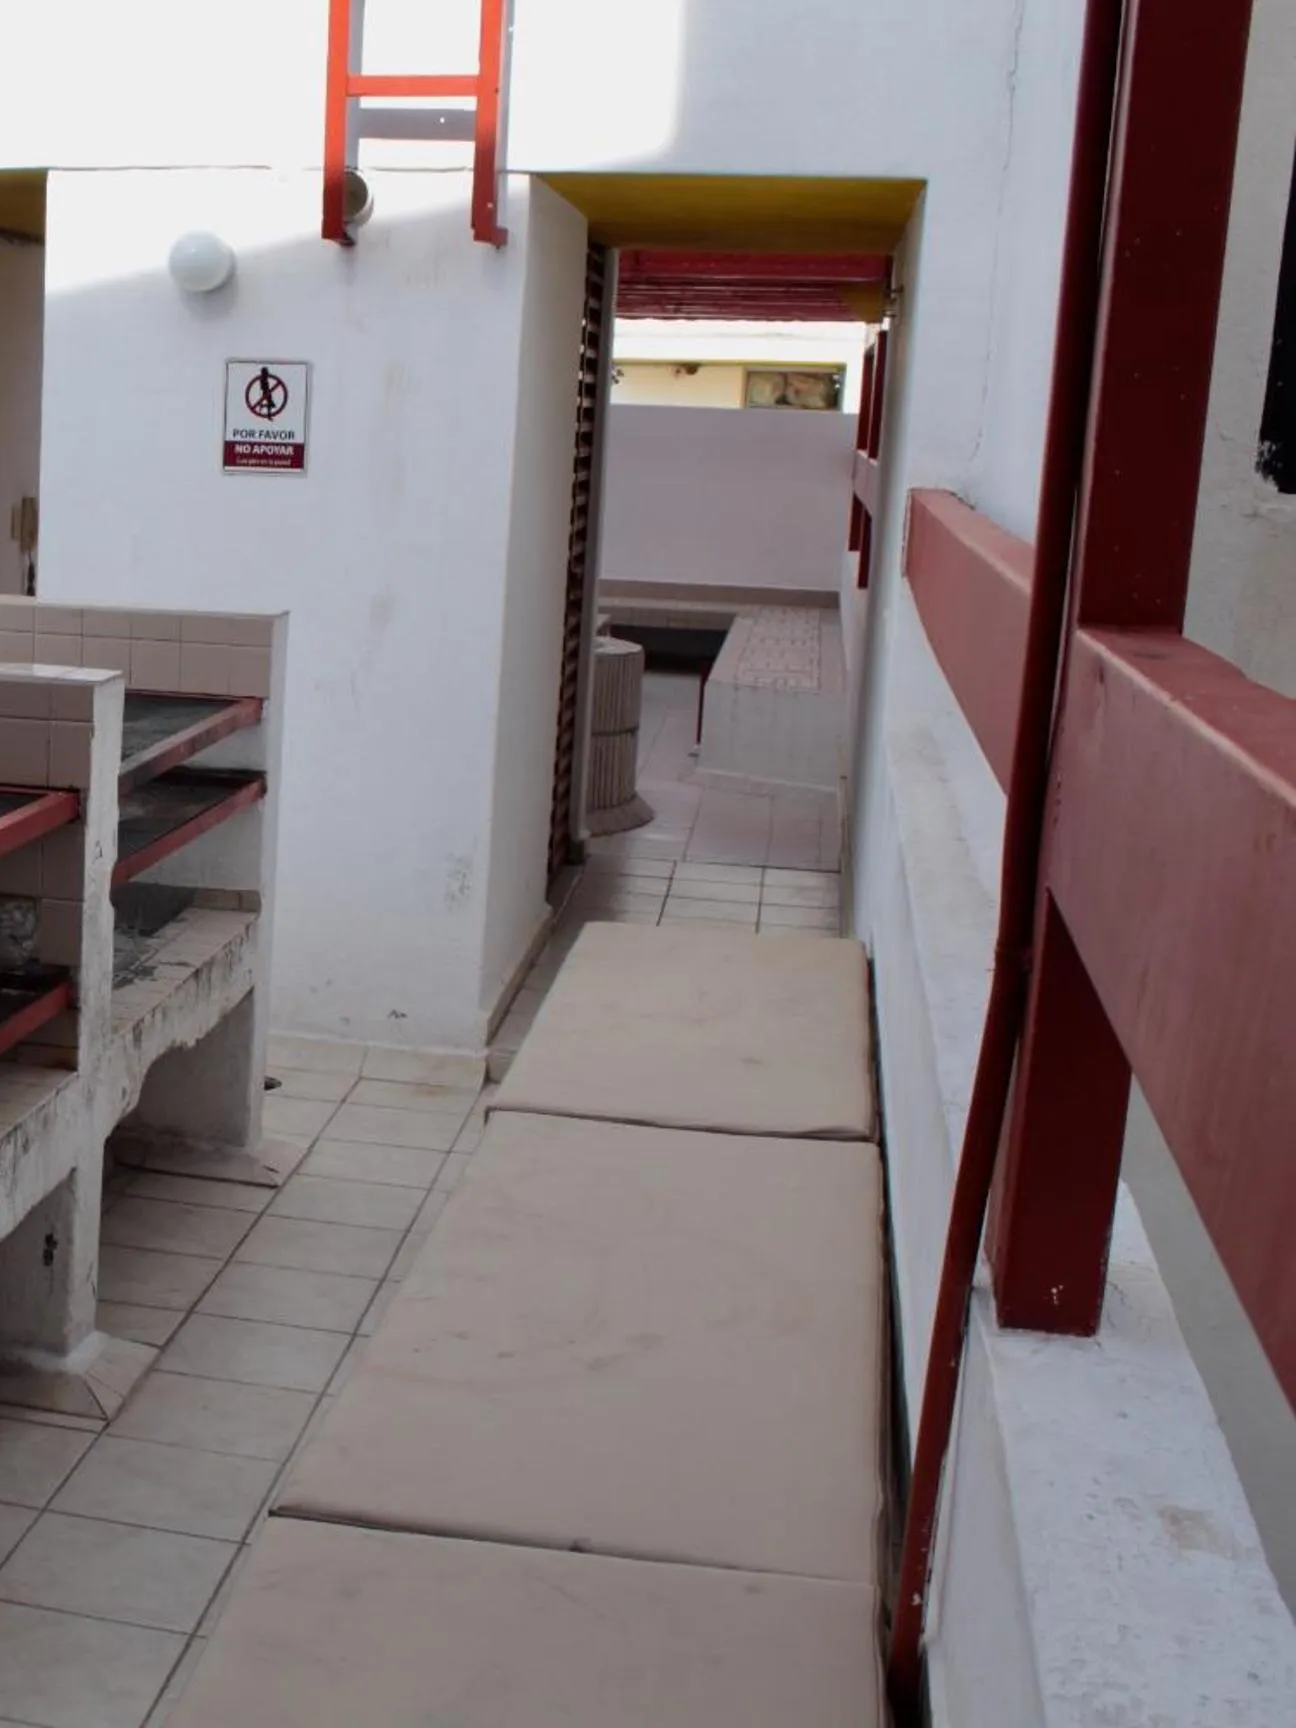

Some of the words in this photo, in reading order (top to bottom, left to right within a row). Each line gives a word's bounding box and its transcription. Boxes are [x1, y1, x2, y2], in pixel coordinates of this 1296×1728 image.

[232, 429, 256, 439] POR
[258, 430, 295, 440] FAVOR
[234, 444, 251, 454] NO
[252, 445, 294, 455] APOYAR
